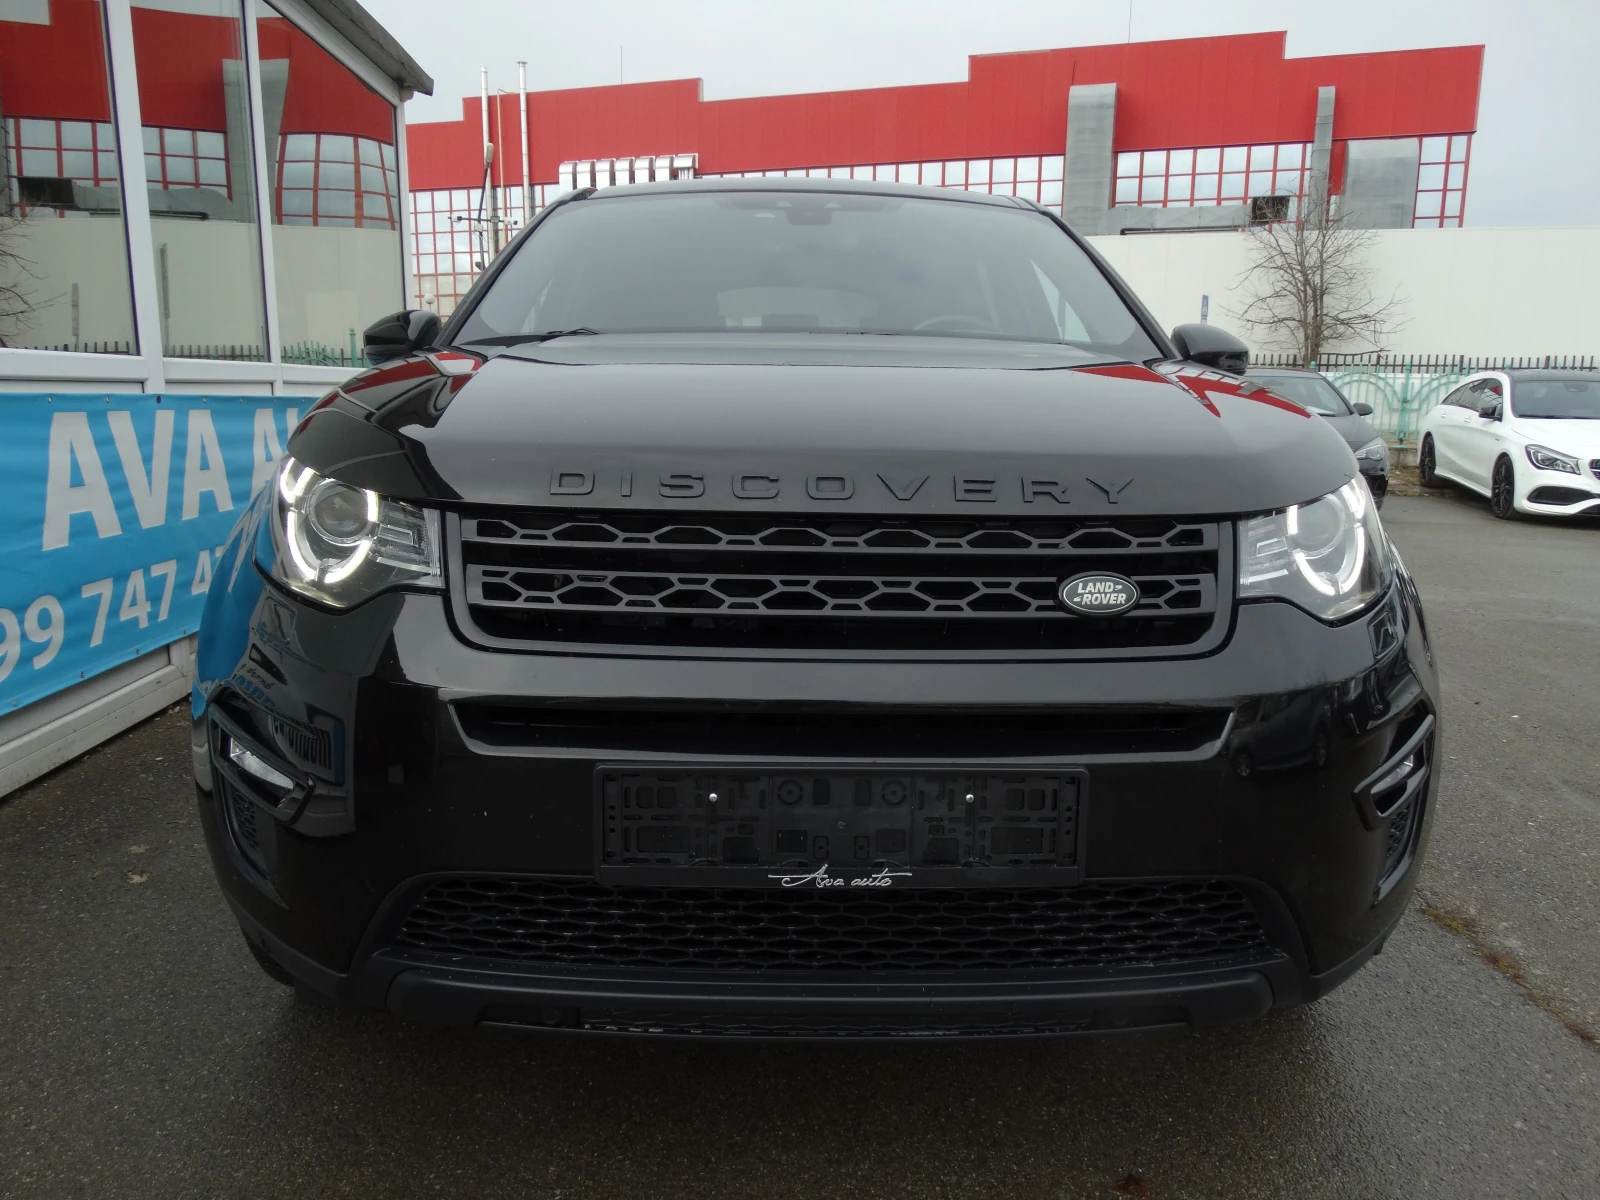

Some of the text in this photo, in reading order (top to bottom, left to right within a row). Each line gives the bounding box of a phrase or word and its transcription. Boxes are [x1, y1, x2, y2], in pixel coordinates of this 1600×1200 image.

[42, 409, 235, 551] AVA
[549, 467, 1134, 504] DISCOVERY
[81, 559, 178, 648] 747
[191, 544, 226, 597] 4
[1077, 582, 1114, 594] LAND
[1081, 593, 1127, 605] ROVER
[768, 863, 913, 888] Ava auto
